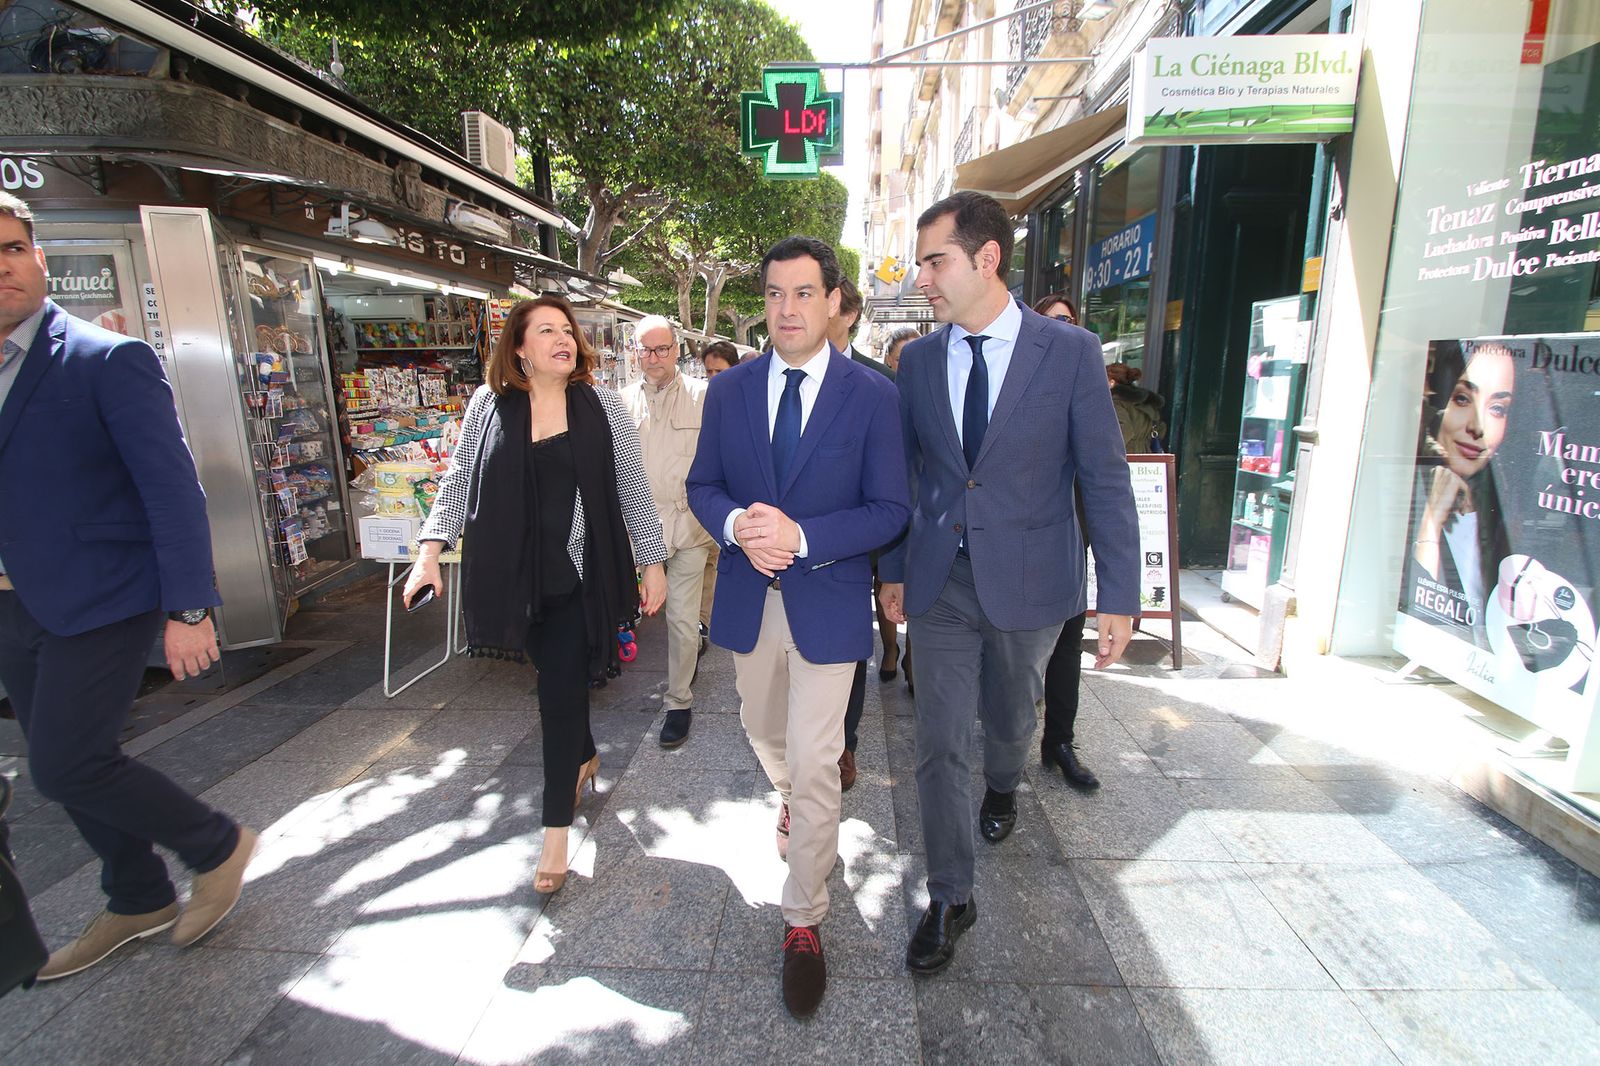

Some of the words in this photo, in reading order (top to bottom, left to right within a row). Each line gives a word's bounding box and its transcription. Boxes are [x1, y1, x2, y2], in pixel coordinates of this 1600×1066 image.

[1152, 55, 1182, 77] La
[1190, 52, 1285, 83] Ciénaga
[1293, 50, 1353, 75] Blvd.
[1161, 86, 1215, 97] Cosmética
[1218, 85, 1234, 96] Bio
[1237, 88, 1244, 98] y
[1247, 85, 1289, 97] Terapias
[1292, 84, 1339, 95] Naturales
[1466, 177, 1511, 198] Valiente
[1519, 152, 1600, 190] Tierna
[1427, 202, 1497, 236] Tenaz
[1505, 181, 1600, 216] Comprensiva
[1101, 224, 1141, 258] HORARIO
[1423, 233, 1495, 259] Luchadora
[1499, 226, 1547, 246] Positiva
[1547, 211, 1600, 246] Bell
[1087, 259, 1111, 291] 9:30
[1123, 246, 1141, 279] 22
[1417, 264, 1471, 281] Protectora
[1471, 250, 1541, 282] Dulce
[1544, 249, 1600, 269] Paciente
[1464, 340, 1526, 359] Protectora
[1530, 342, 1600, 375] Dulce
[1137, 466, 1162, 476] Blvd.
[1561, 467, 1600, 490] ere
[1537, 484, 1600, 519] únic
[1415, 586, 1477, 626] REGALO
